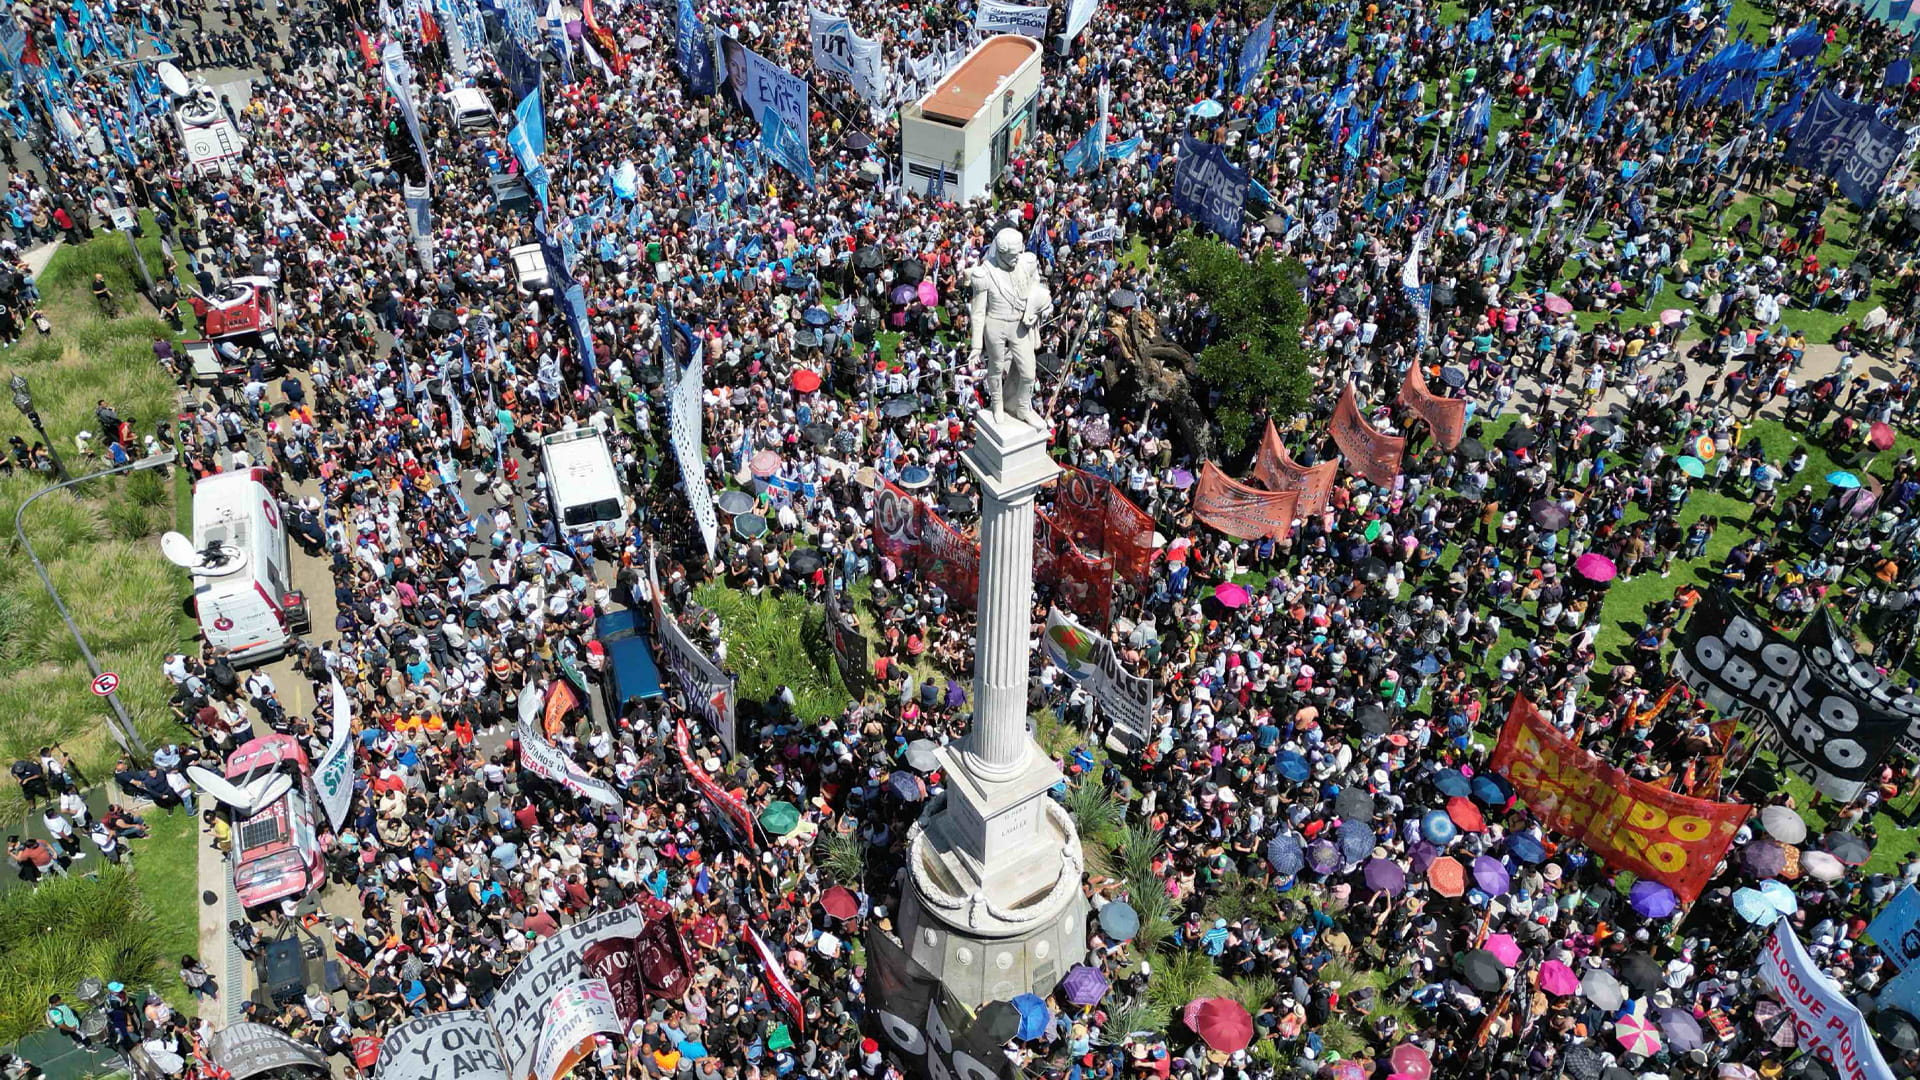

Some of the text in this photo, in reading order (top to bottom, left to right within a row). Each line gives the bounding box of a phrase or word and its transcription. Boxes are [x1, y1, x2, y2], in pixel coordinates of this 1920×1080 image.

[758, 76, 802, 121] Evita
[1188, 154, 1246, 207] LIBRES
[1696, 635, 1868, 768] OBRERO
[1723, 615, 1859, 732] POLO
[1765, 933, 1827, 1019] BLOQUE
